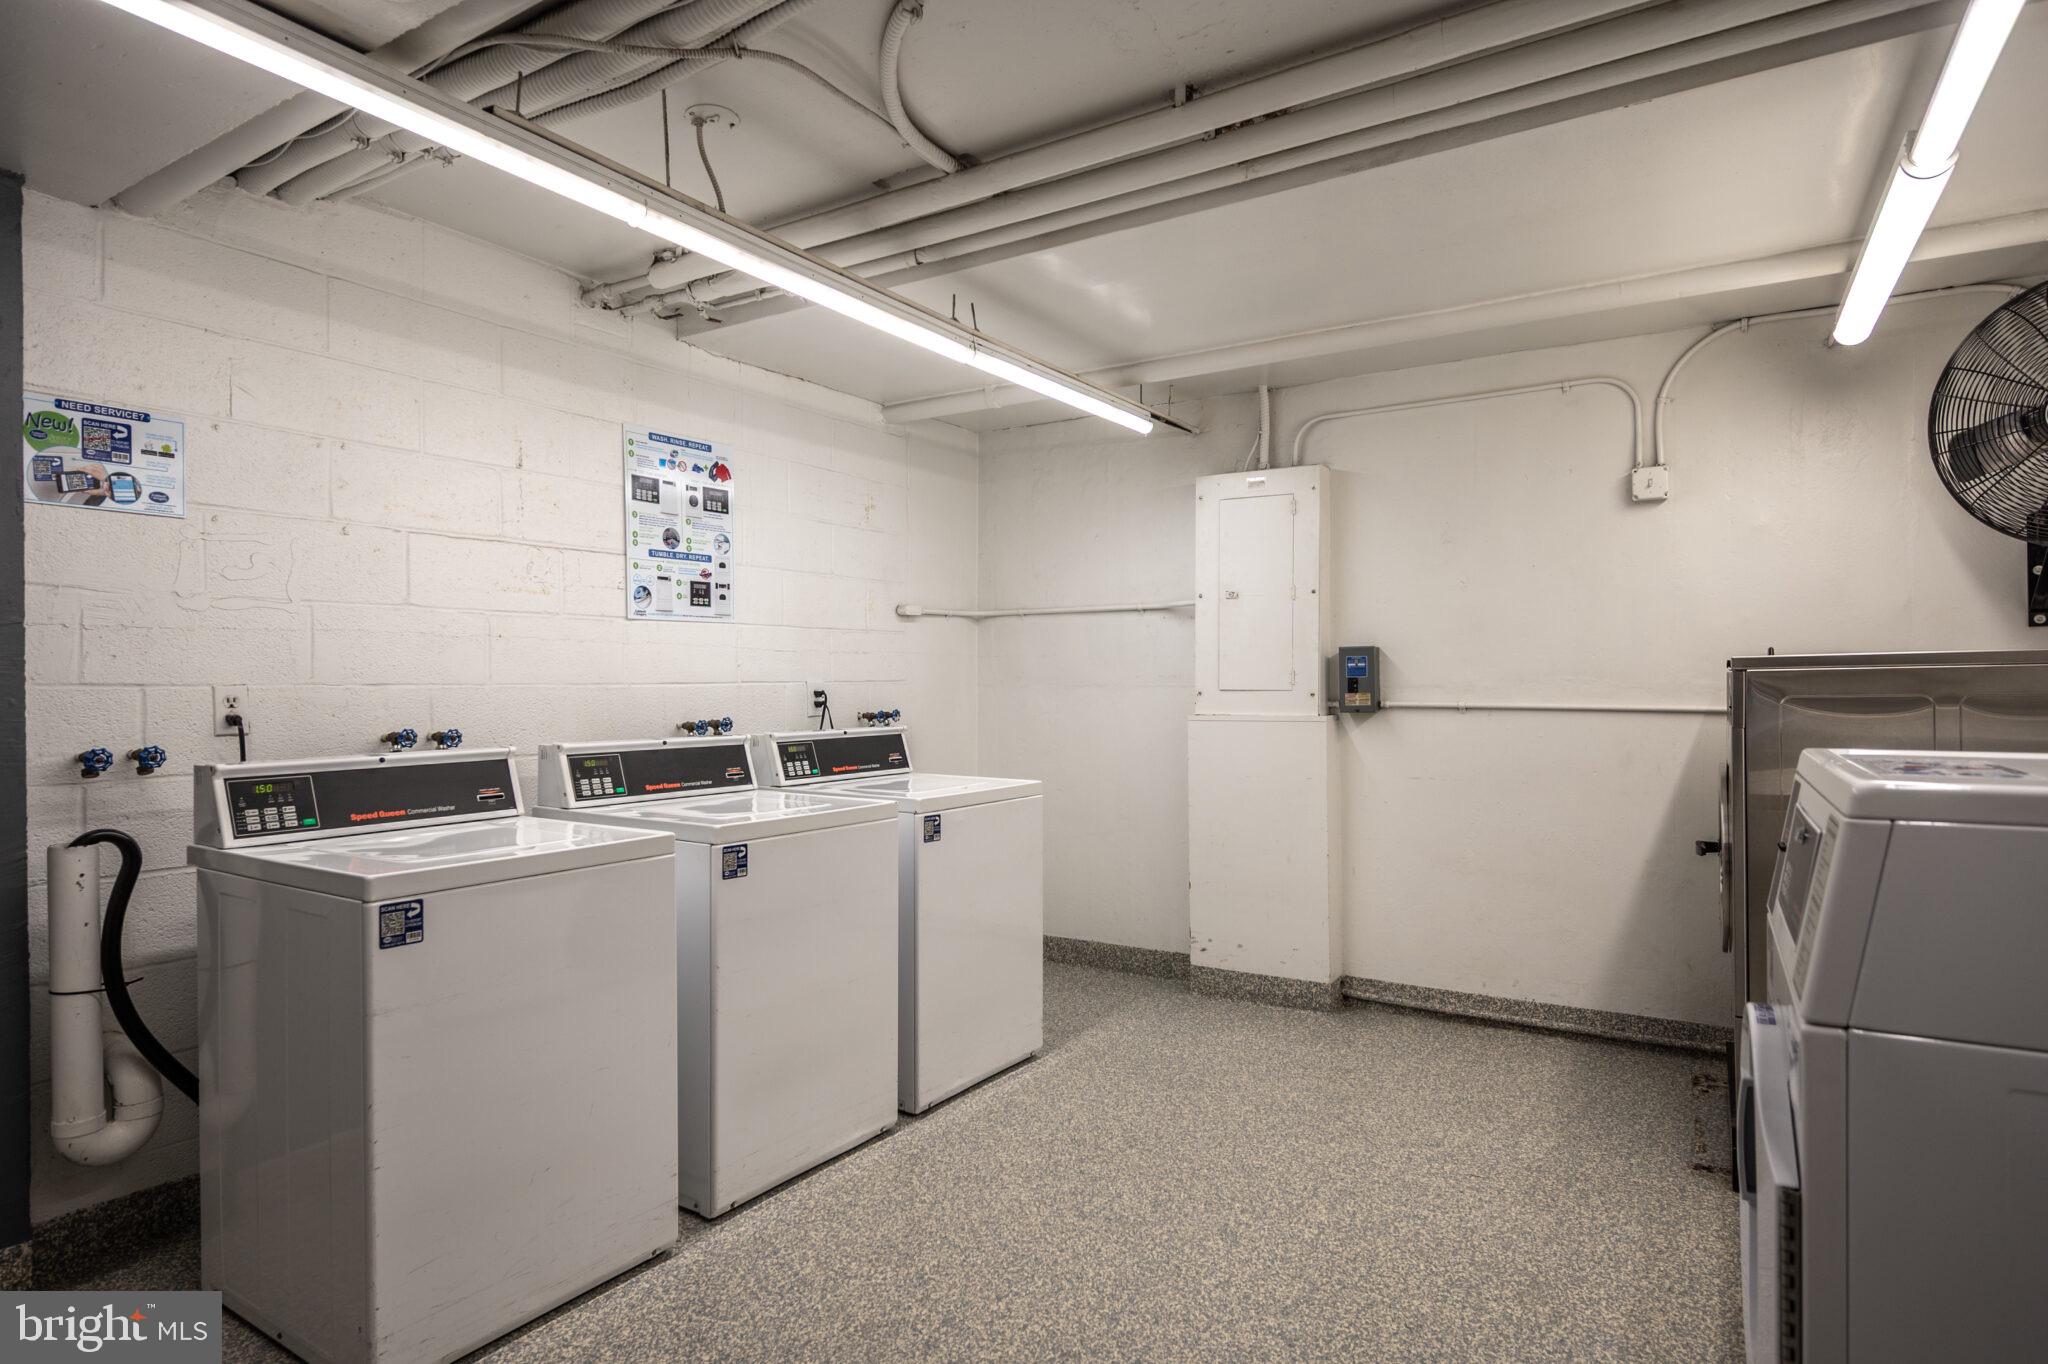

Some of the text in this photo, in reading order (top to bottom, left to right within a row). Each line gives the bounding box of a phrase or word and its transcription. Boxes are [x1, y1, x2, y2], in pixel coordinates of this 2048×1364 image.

[61, 401, 145, 421] NEED SERVICE?
[25, 412, 74, 433] New!
[350, 805, 456, 821] Speed Queen Commercial Washer
